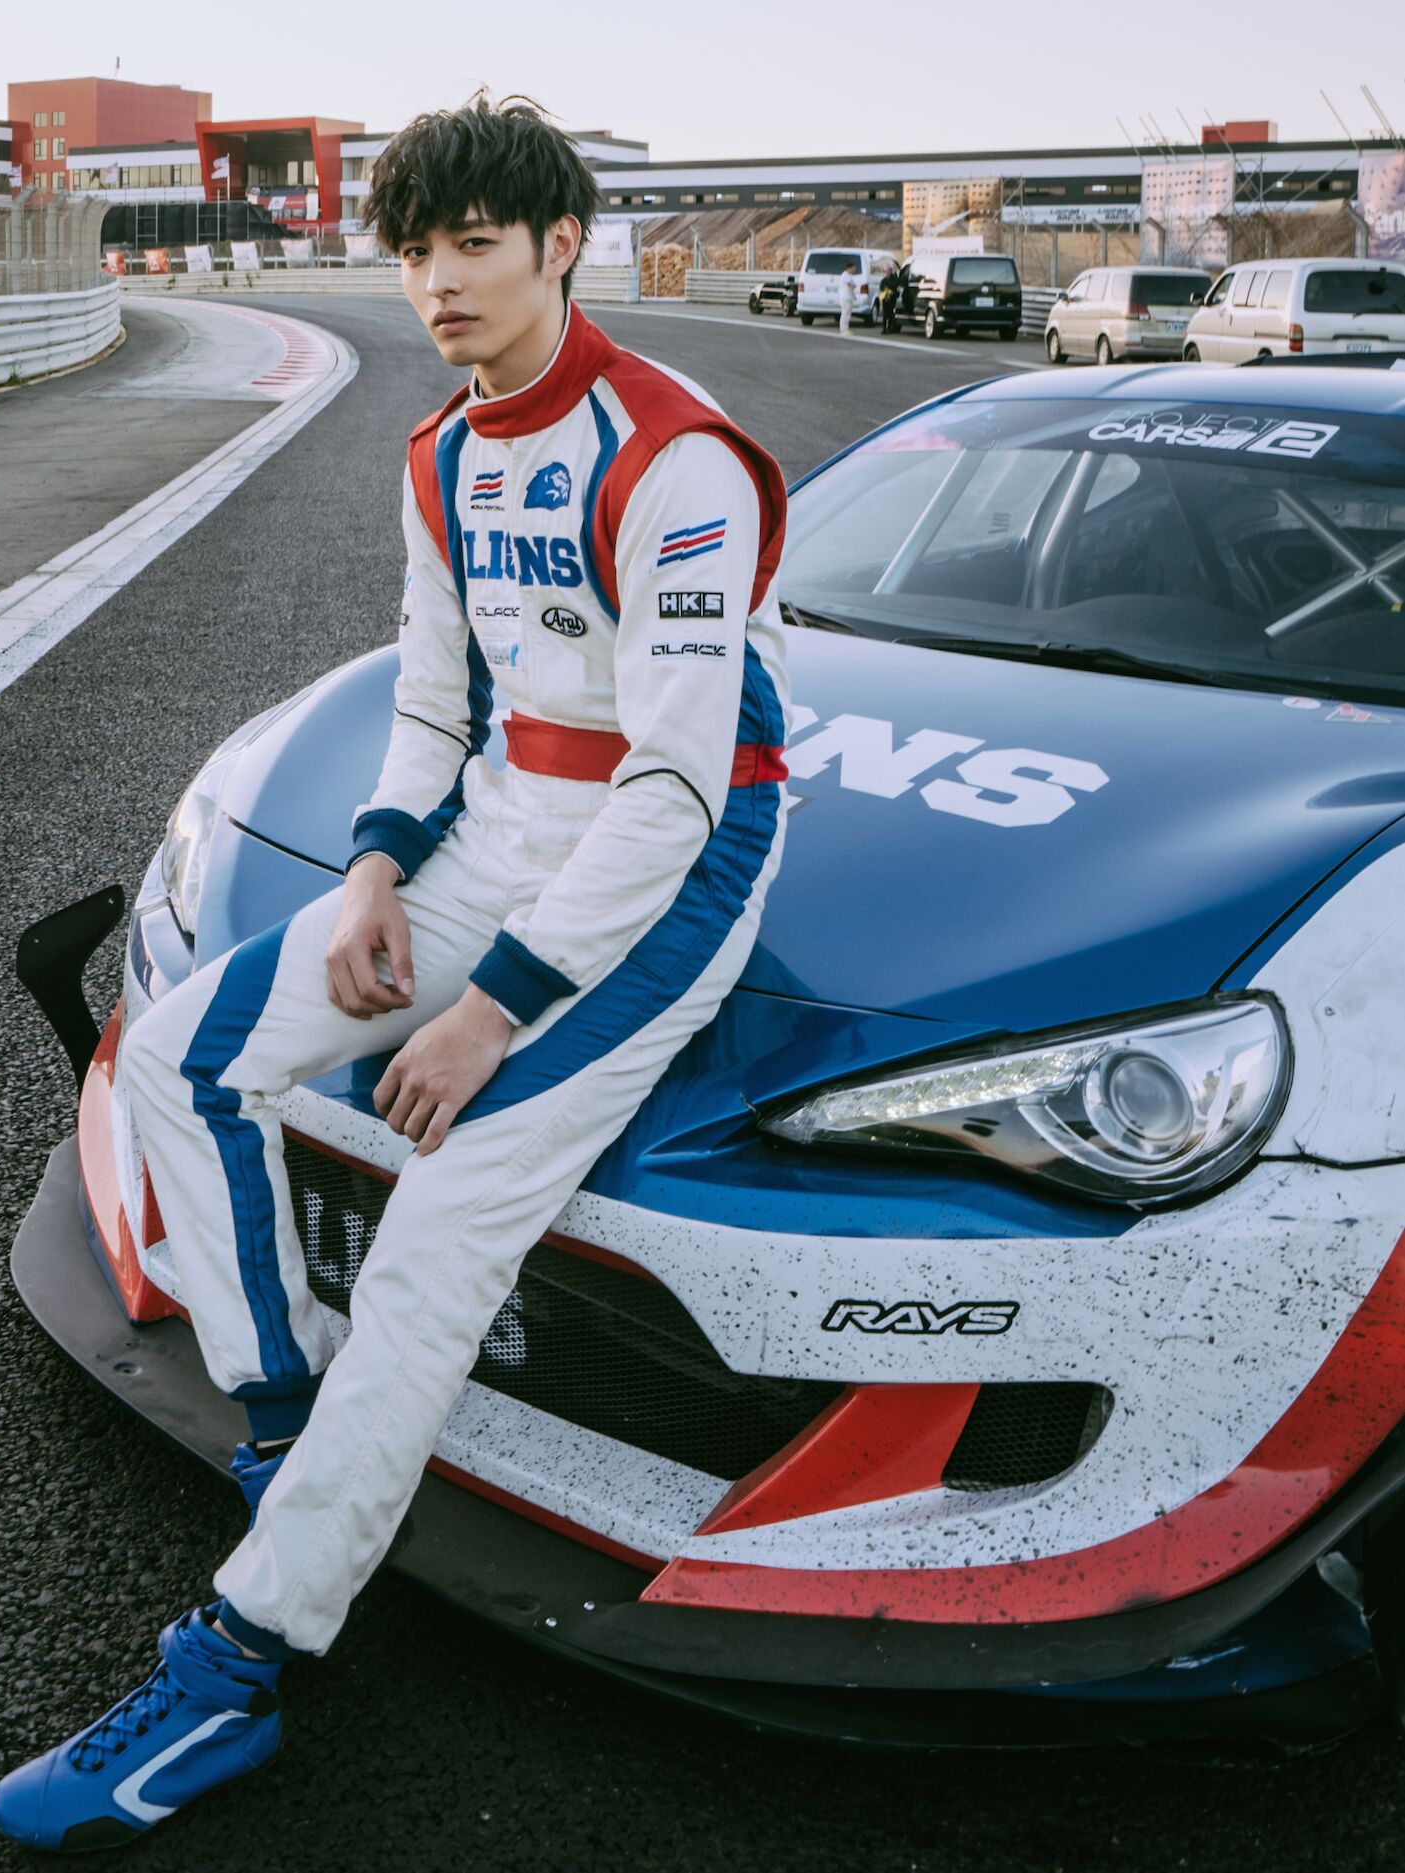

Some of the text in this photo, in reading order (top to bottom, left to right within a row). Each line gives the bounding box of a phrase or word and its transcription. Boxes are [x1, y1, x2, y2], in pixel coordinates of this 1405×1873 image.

[1101, 410, 1284, 434] PROJECT
[1089, 422, 1335, 456] CARS 2
[660, 593, 723, 613] HKS
[544, 608, 584, 632] Arai
[822, 1300, 1020, 1334] RAYS
